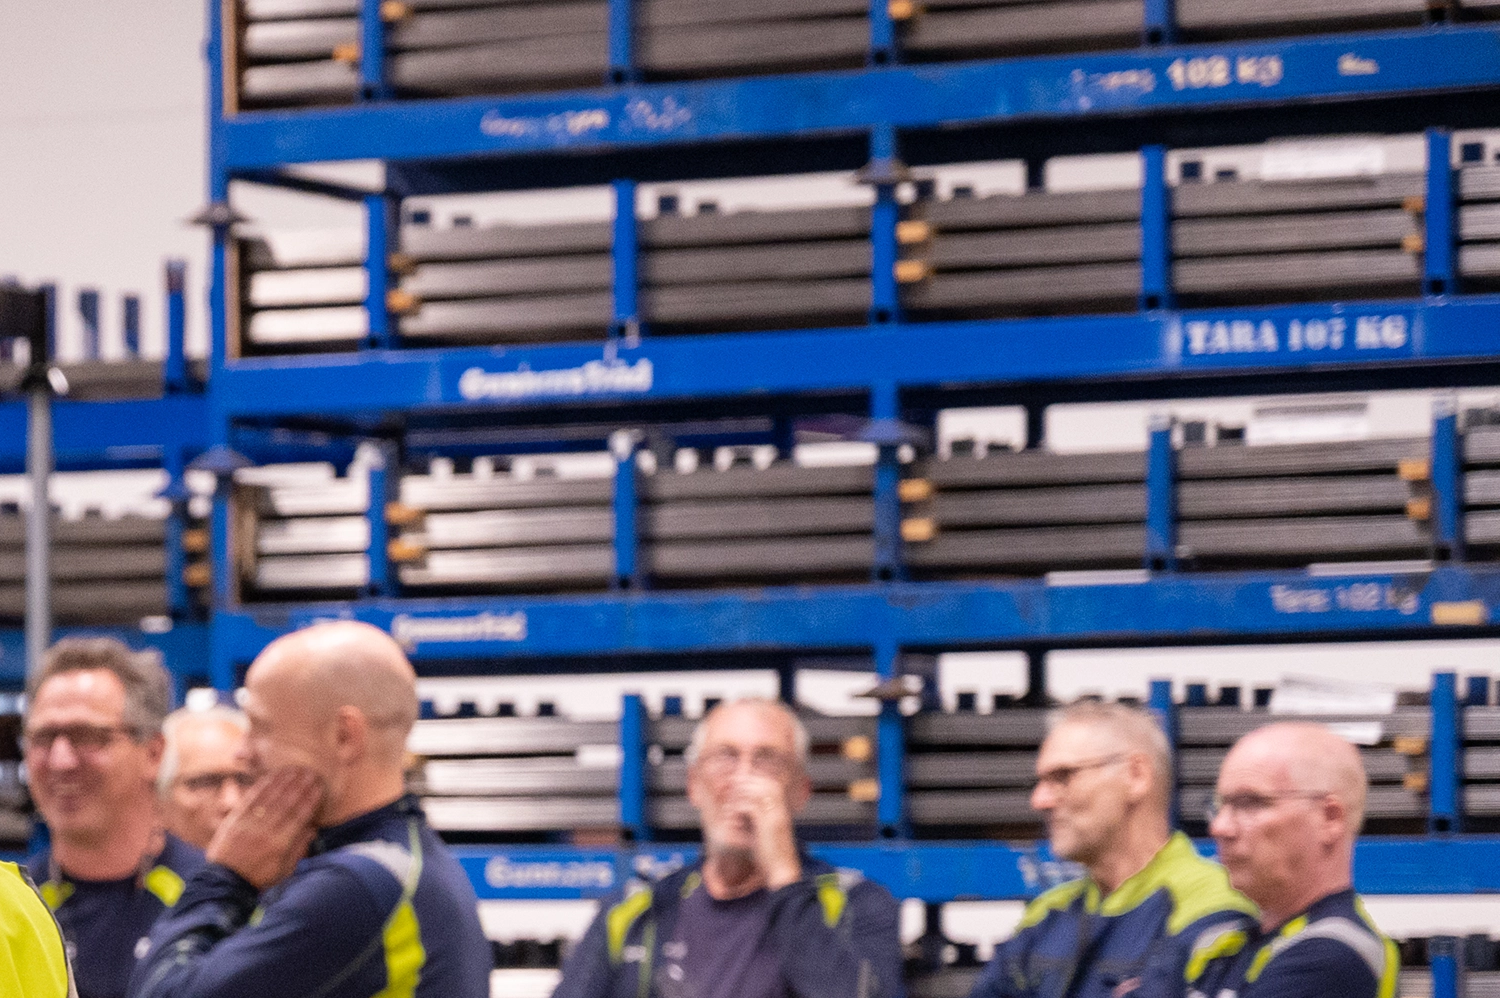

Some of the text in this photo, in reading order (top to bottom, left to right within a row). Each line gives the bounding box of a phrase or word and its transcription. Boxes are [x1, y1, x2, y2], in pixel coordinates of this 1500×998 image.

[1187, 314, 1407, 354] TARA 107 KG
